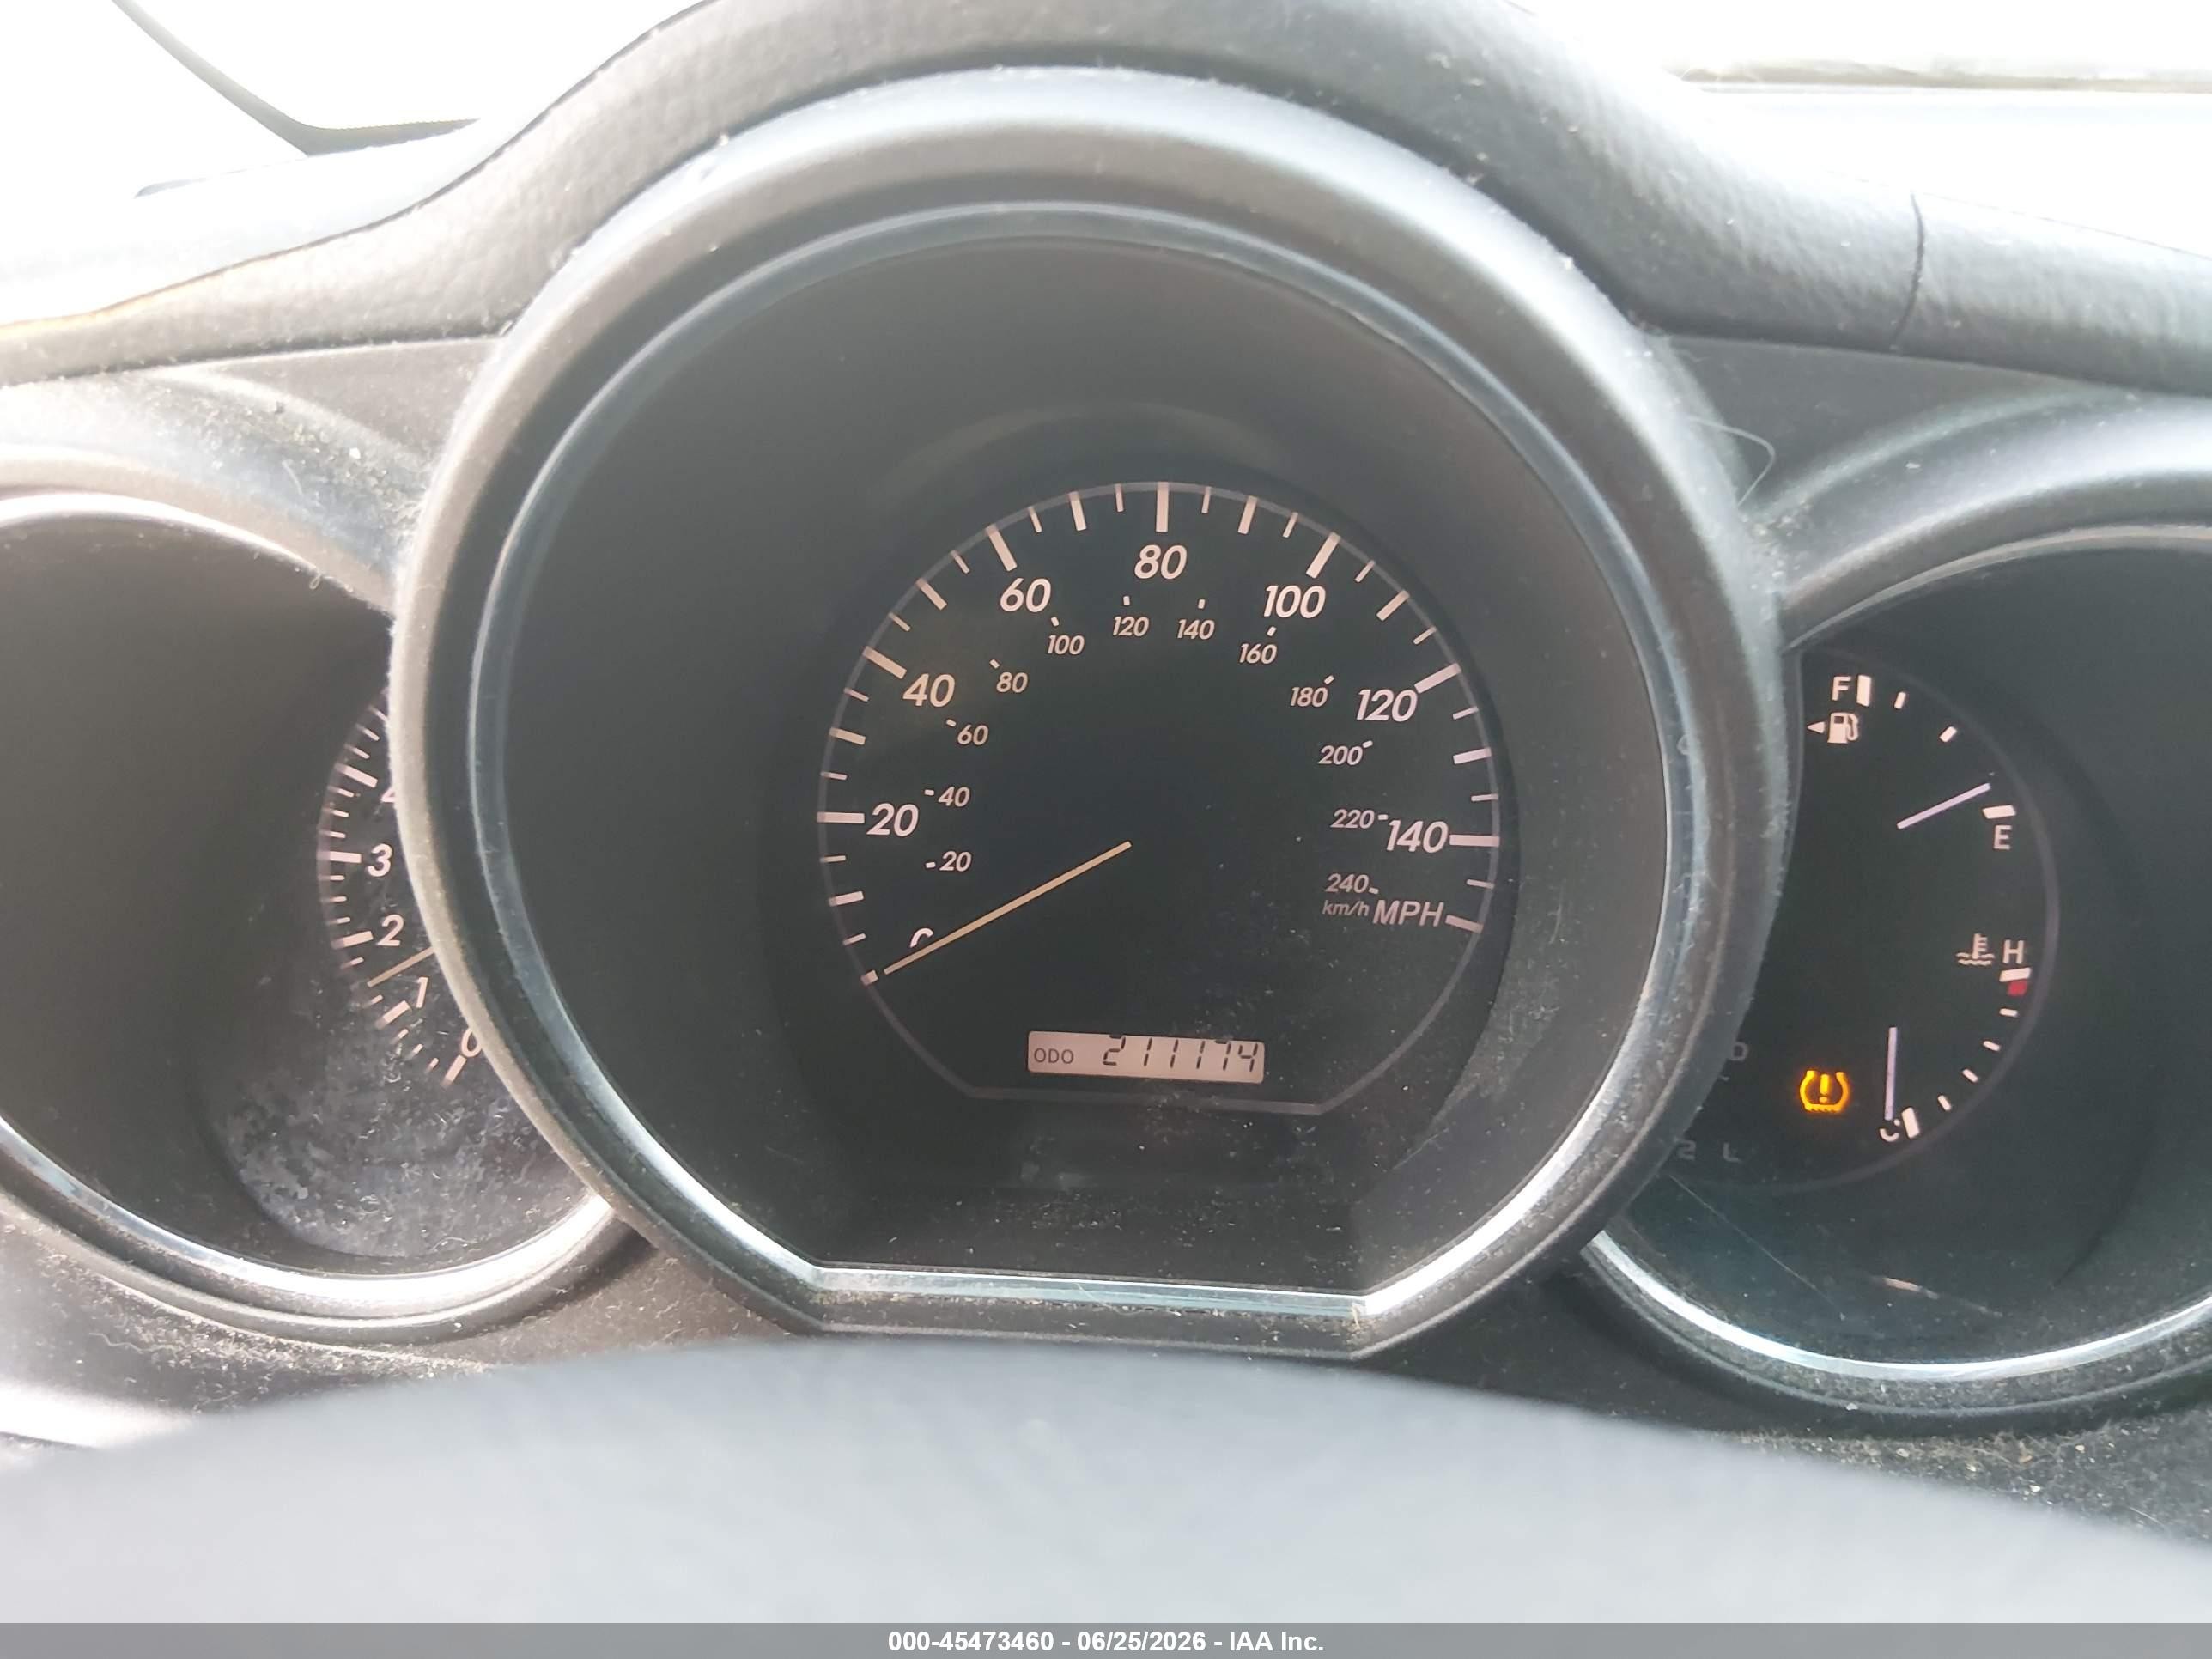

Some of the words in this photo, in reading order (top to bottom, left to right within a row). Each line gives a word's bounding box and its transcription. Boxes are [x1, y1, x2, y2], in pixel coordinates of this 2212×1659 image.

[1135, 545, 1187, 579] 80
[1000, 578, 1051, 612] 60
[1264, 586, 1325, 618] 100
[1113, 617, 1149, 636] 120
[1178, 619, 1214, 639] 140
[1048, 635, 1085, 655] 100
[1240, 644, 1277, 664] 160
[903, 673, 956, 707] 40
[996, 672, 1028, 692] 80
[1832, 677, 1851, 701] F
[1291, 687, 1328, 707] 180
[1357, 689, 1418, 722] 120
[957, 725, 988, 745] 60
[1318, 745, 1363, 765] 200
[939, 787, 969, 807] 40
[866, 804, 919, 837] 20
[1330, 810, 1374, 830] 220
[1387, 820, 1449, 854] 140
[1994, 825, 2011, 849] E
[368, 843, 392, 877] 3
[939, 851, 971, 872] 20
[1325, 873, 1370, 894] 240
[1322, 898, 1370, 917] km/h
[1374, 900, 1443, 927] MPH
[378, 914, 404, 946] 2
[2003, 940, 2024, 963] H
[416, 977, 428, 1008] 1
[1034, 1047, 1074, 1065] ODO
[1103, 1034, 1258, 1072] 211174
